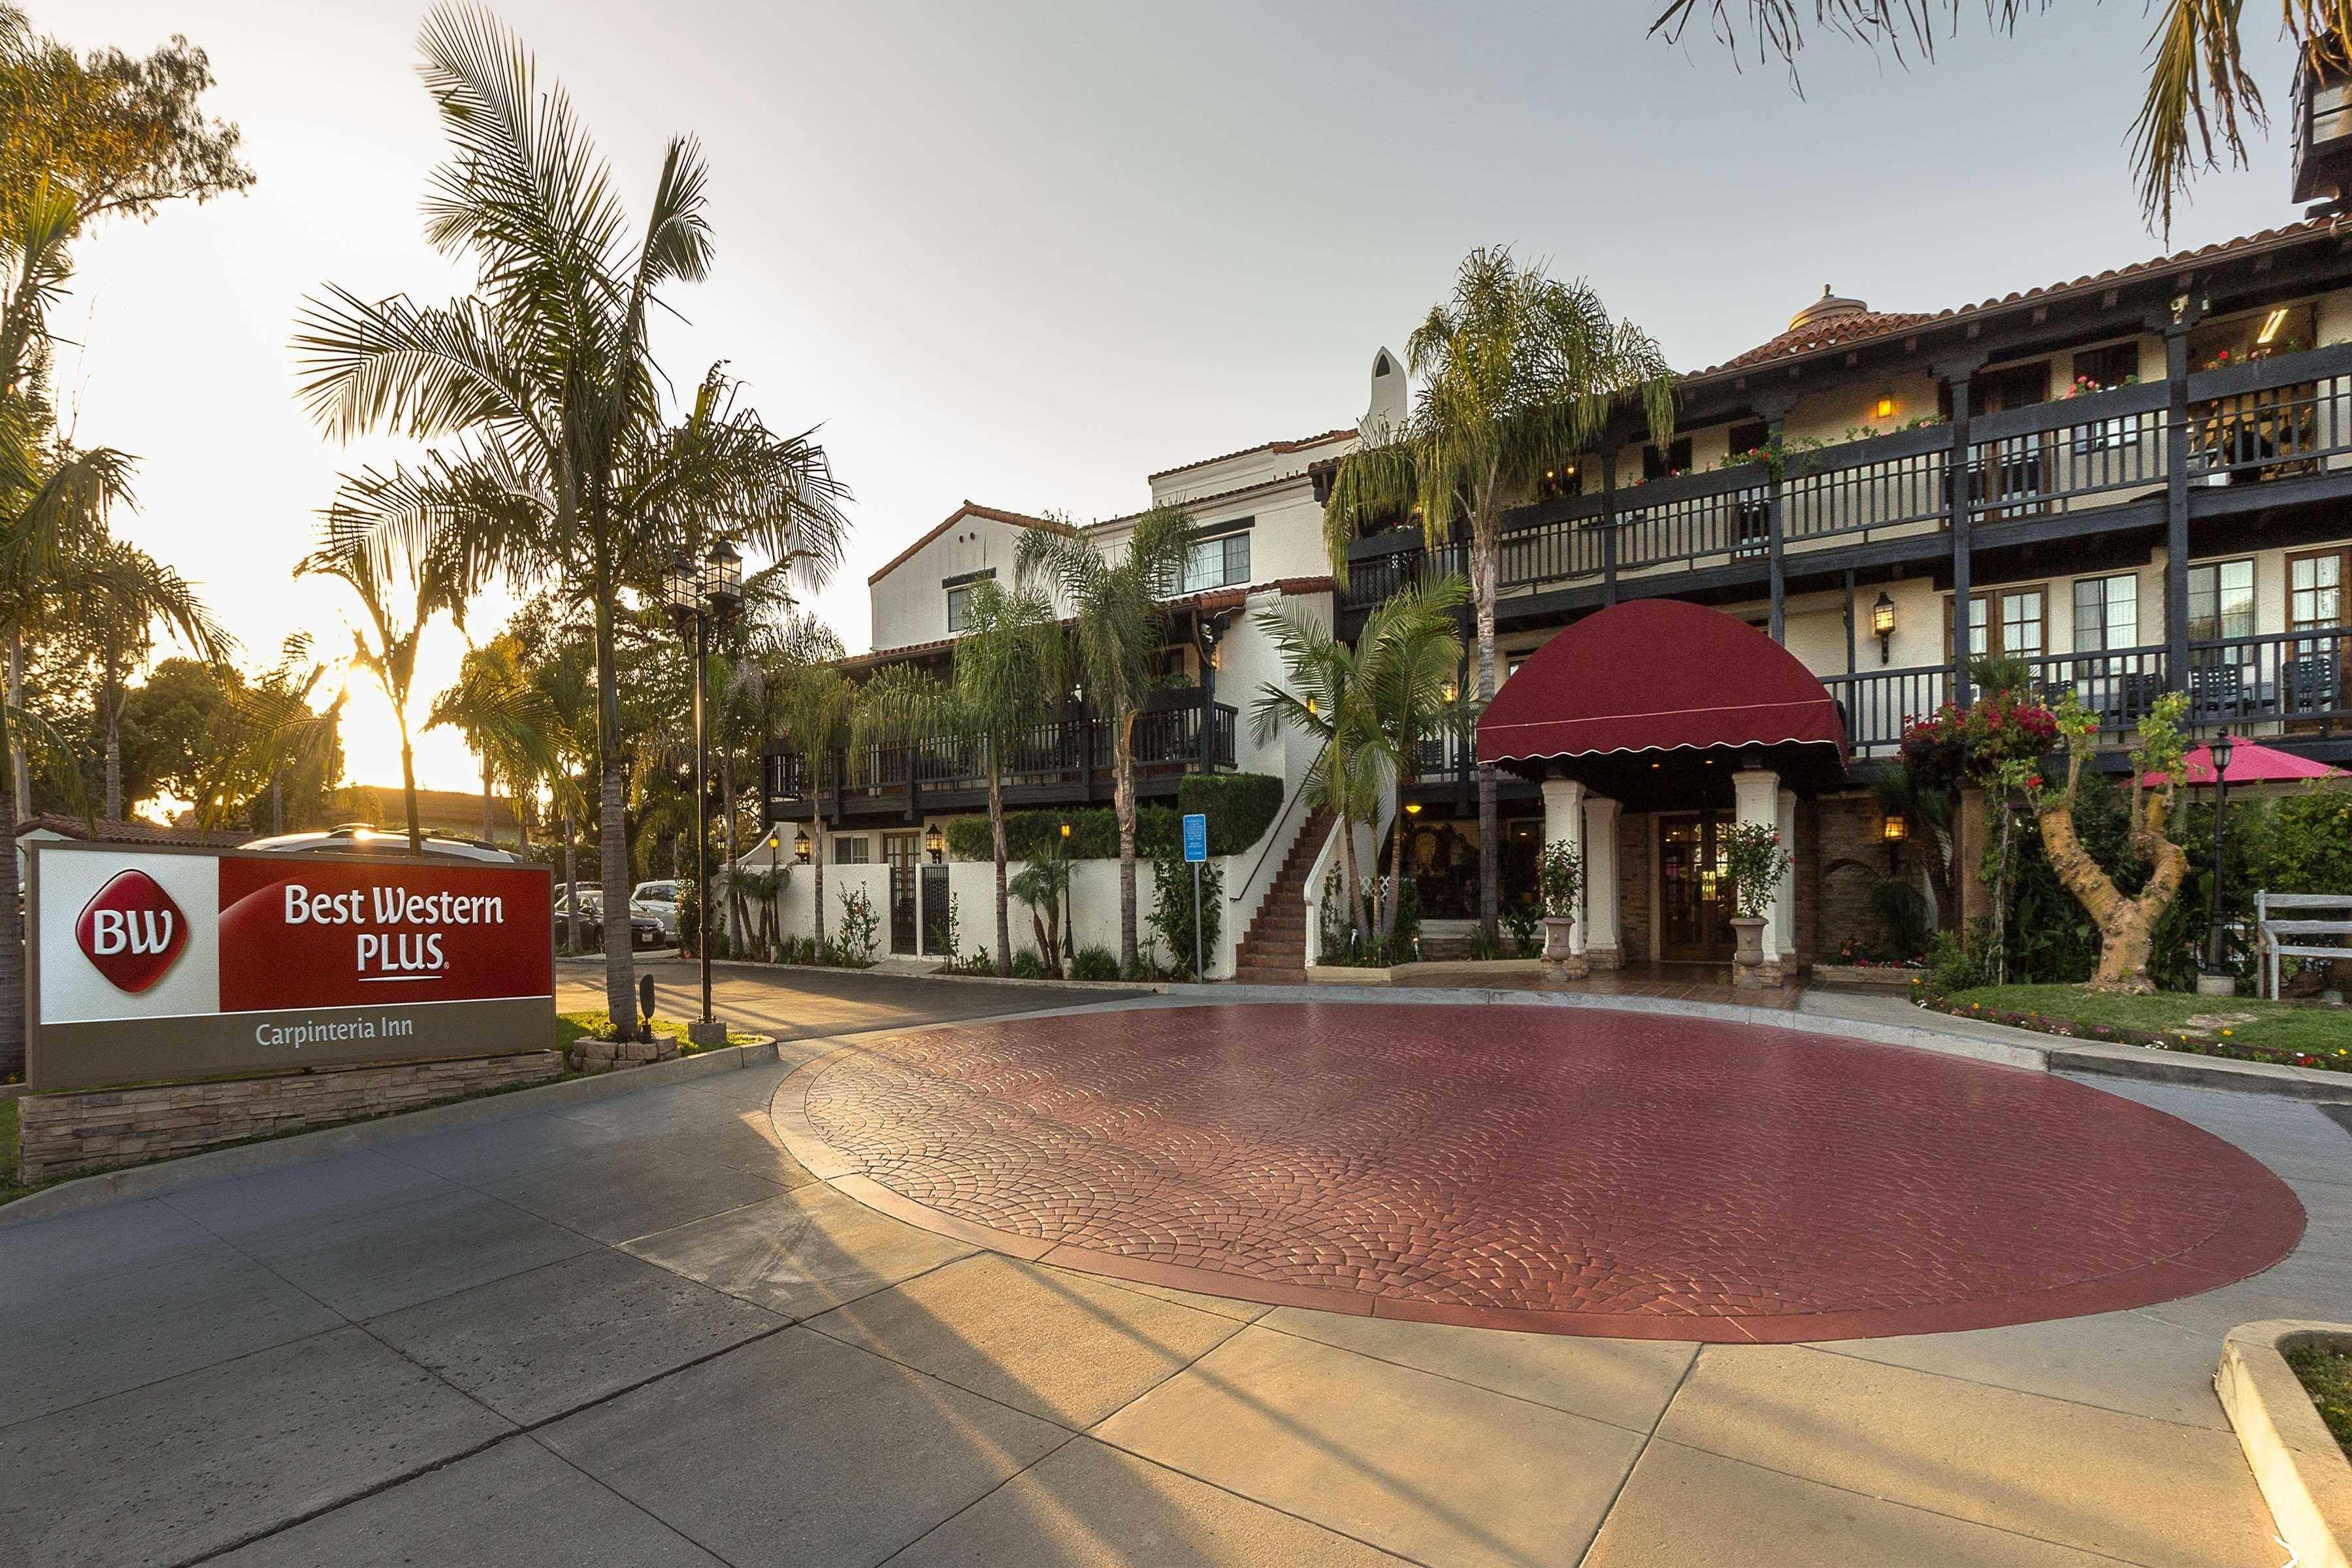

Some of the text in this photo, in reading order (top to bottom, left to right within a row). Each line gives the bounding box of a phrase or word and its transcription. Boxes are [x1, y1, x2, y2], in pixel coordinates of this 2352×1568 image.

[285, 885, 504, 924] Best Western
[93, 909, 173, 955] BW
[255, 1017, 414, 1049] Carpinteria Inn
